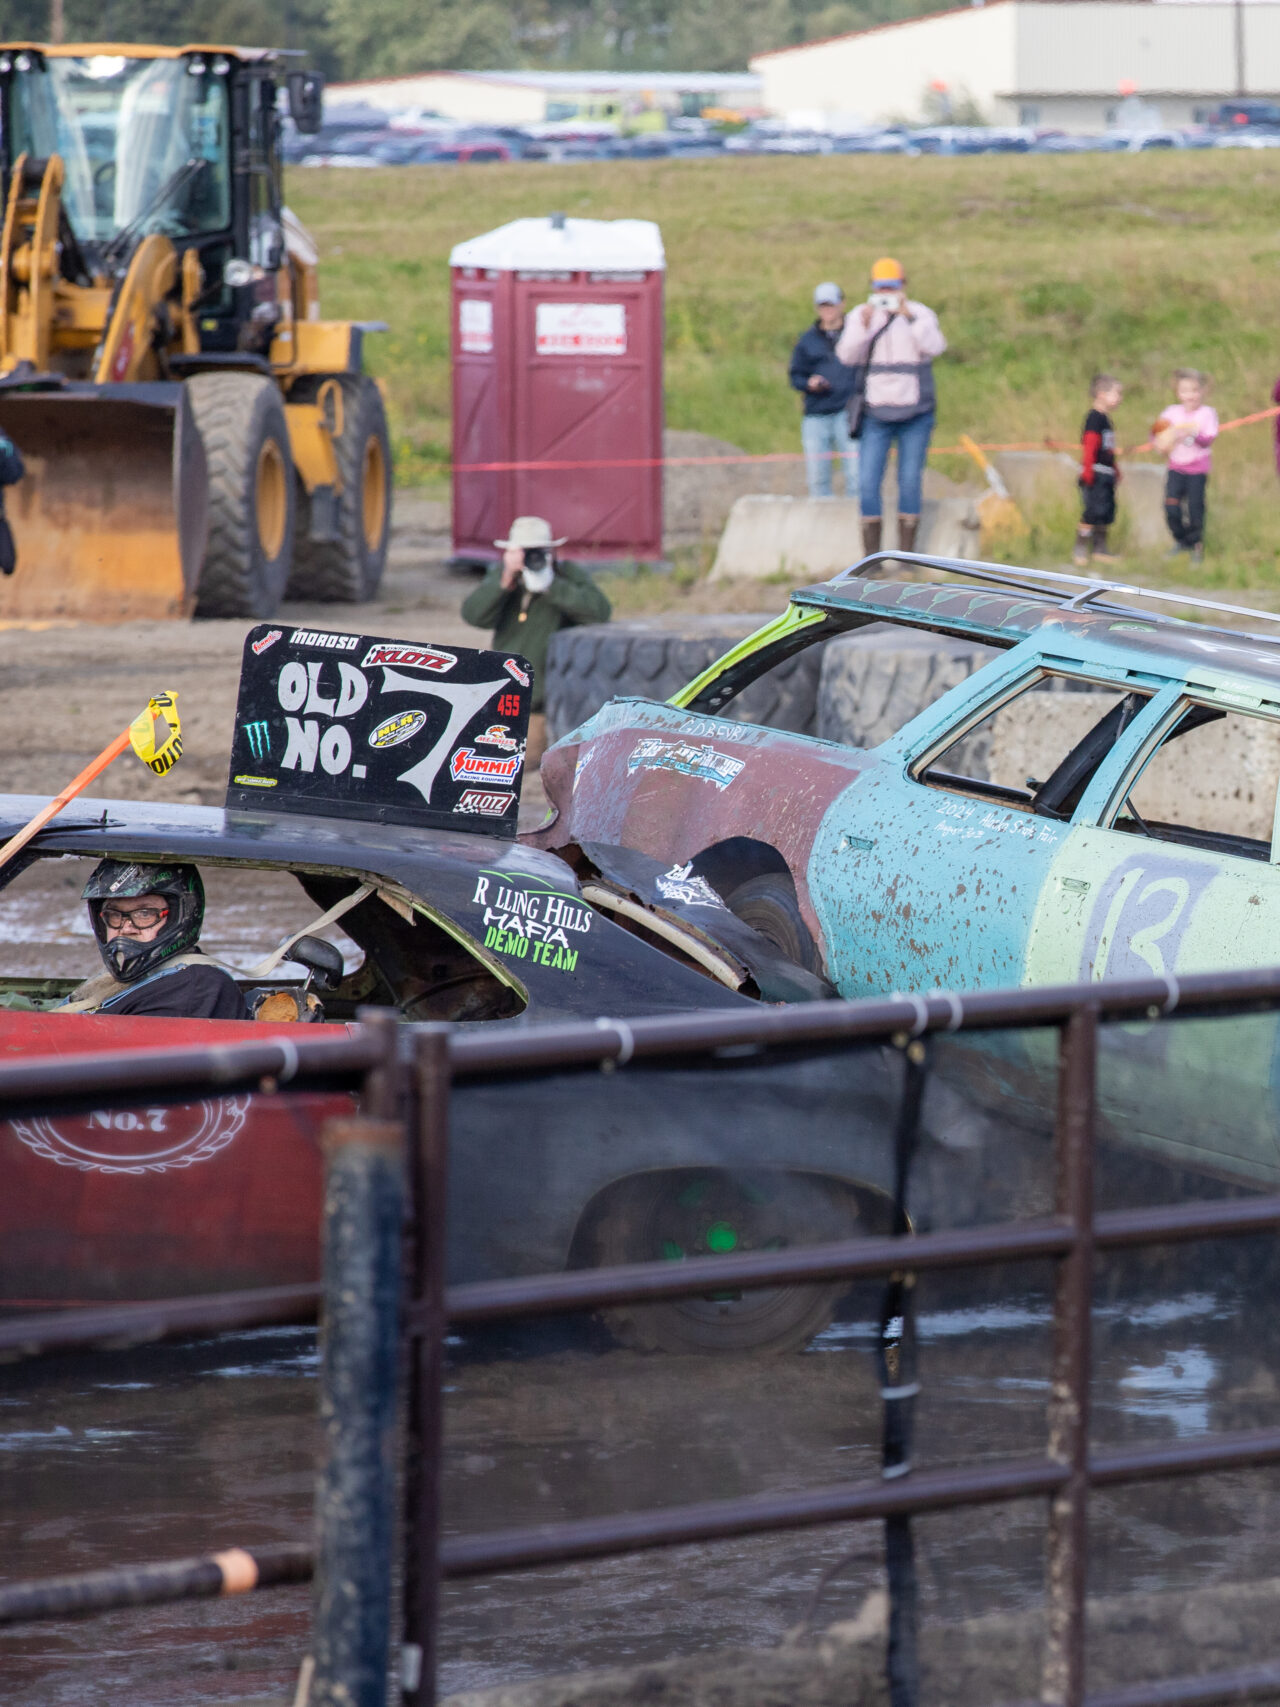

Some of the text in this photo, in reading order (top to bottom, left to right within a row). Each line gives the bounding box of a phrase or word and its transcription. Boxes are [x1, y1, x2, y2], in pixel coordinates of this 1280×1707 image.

[290, 631, 359, 649] MOROSO
[370, 651, 454, 669] KLOTZ
[278, 662, 368, 716] OLD
[497, 694, 520, 716] 455
[281, 717, 367, 778] NO.
[381, 667, 511, 804] 7
[462, 793, 509, 810] KLOTZ
[483, 907, 569, 949] MAFIA
[542, 896, 593, 933] HILLS
[484, 926, 579, 972] DEMO TEAM
